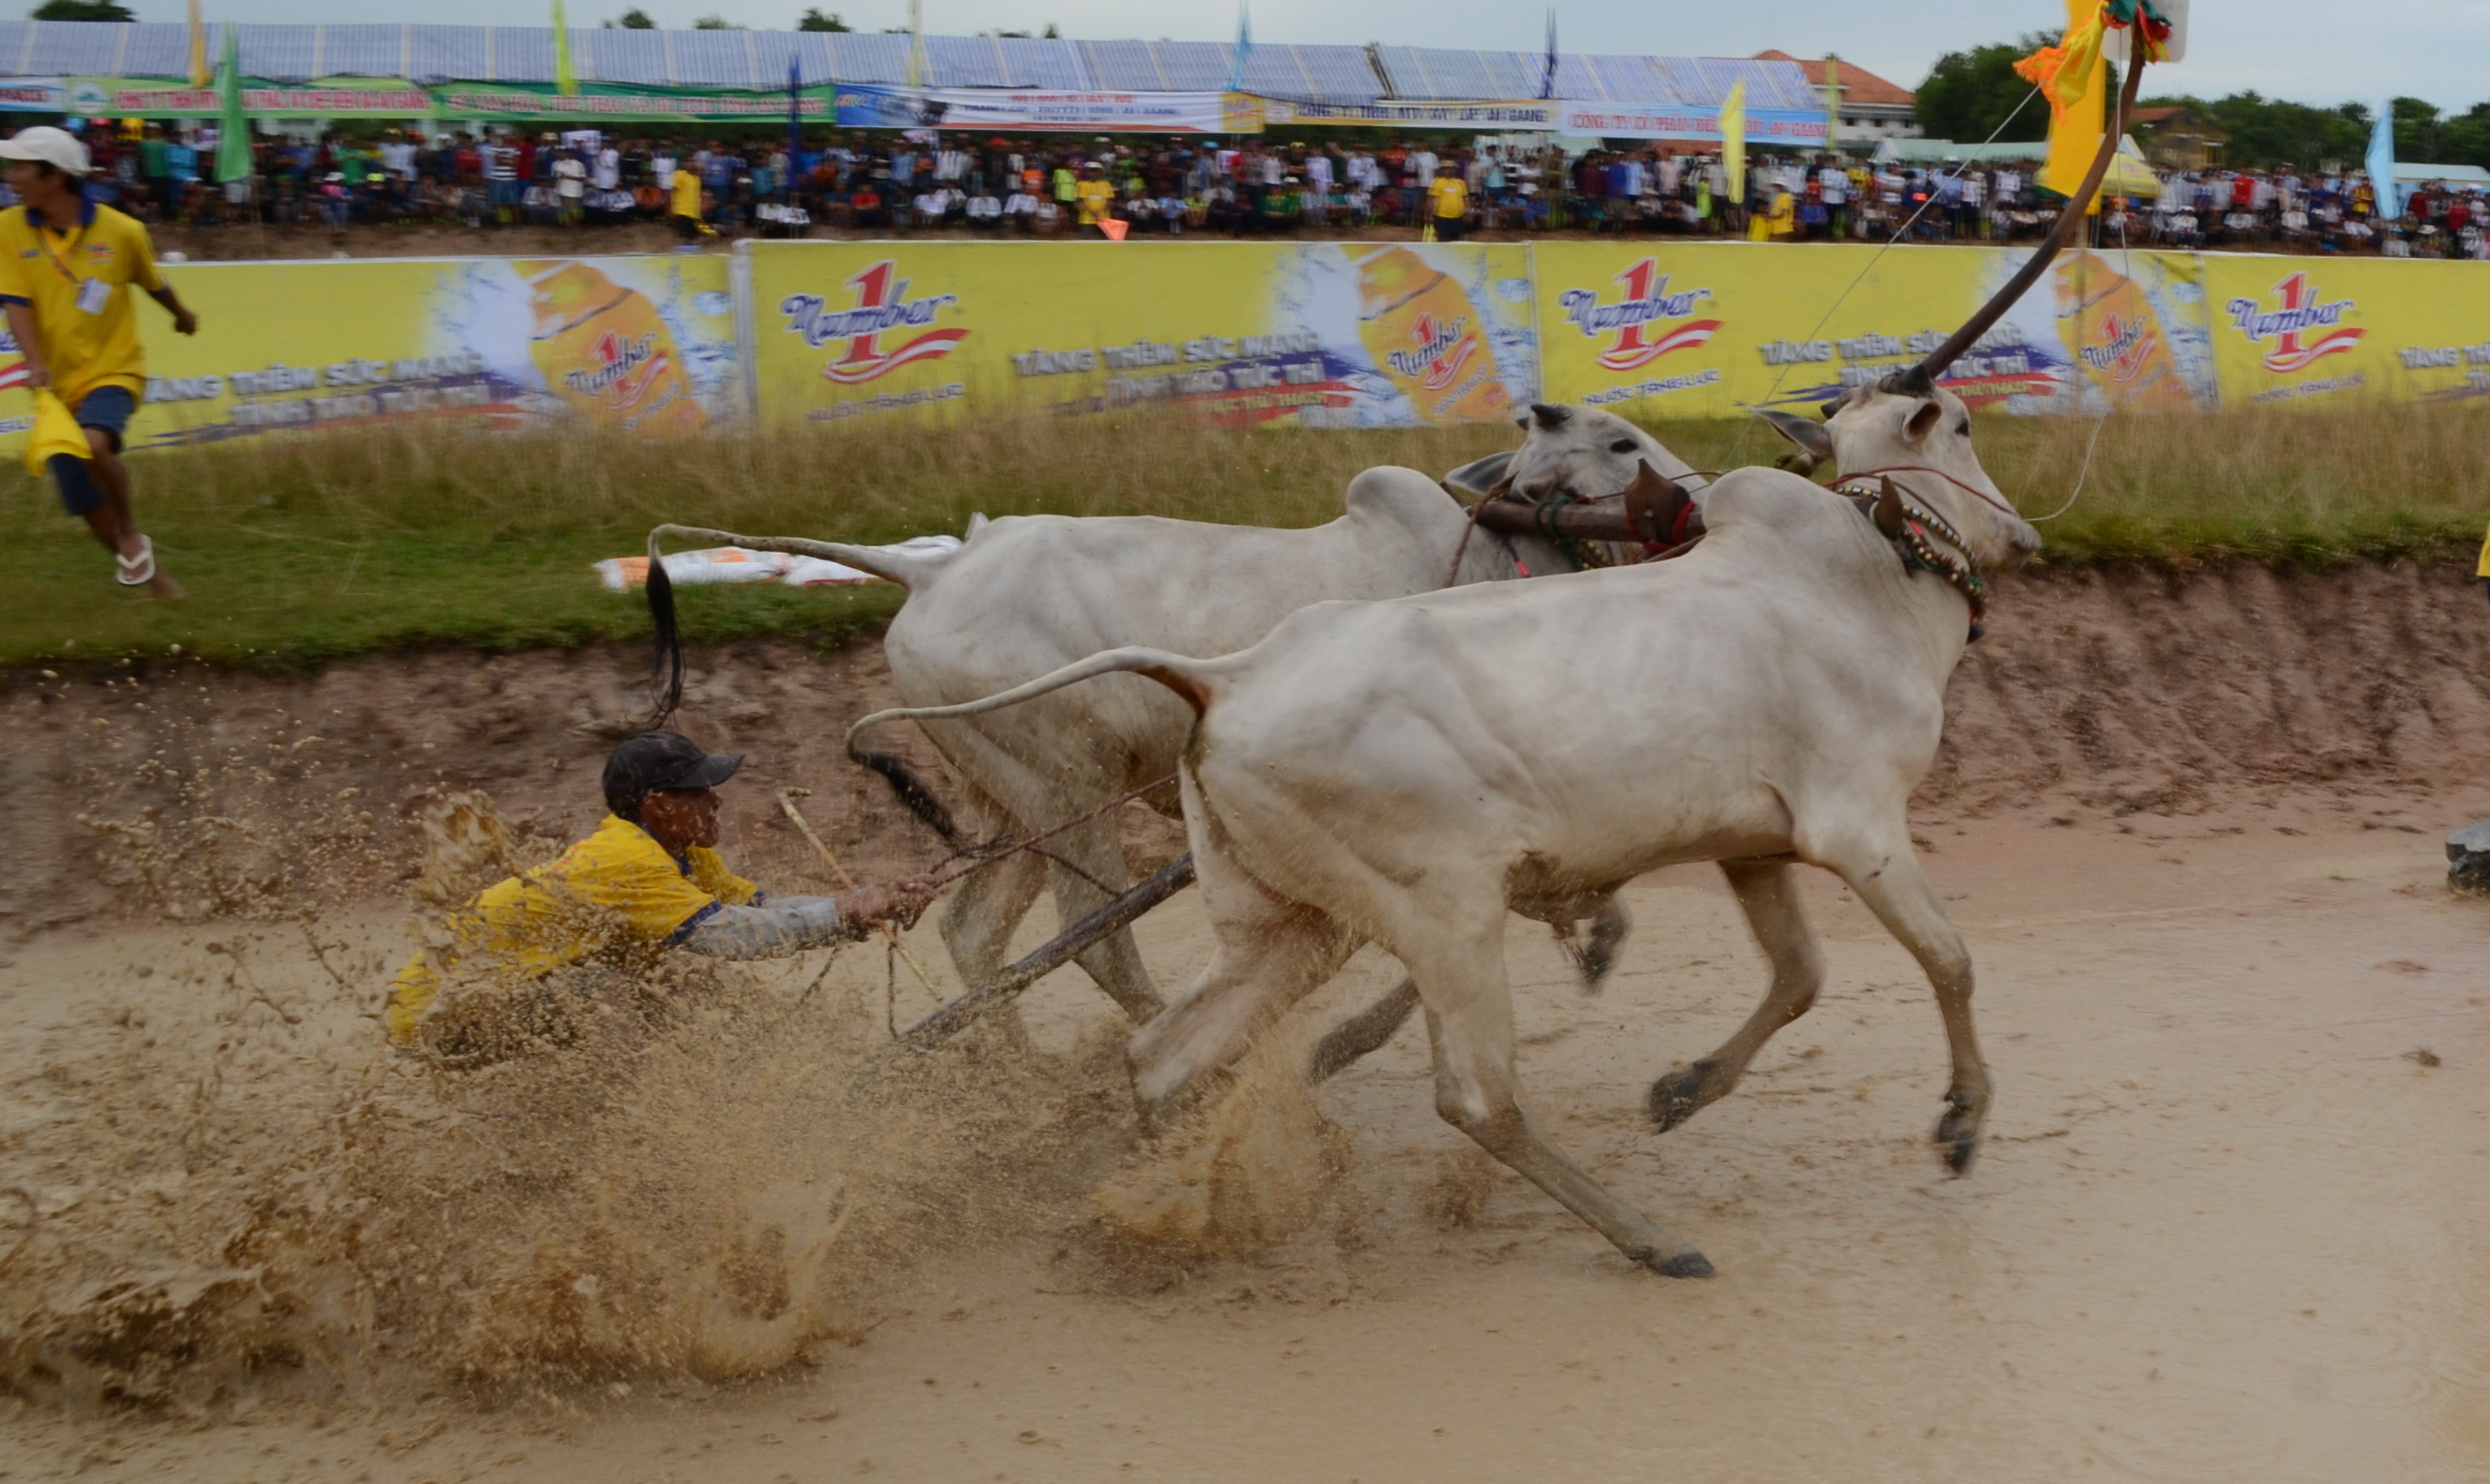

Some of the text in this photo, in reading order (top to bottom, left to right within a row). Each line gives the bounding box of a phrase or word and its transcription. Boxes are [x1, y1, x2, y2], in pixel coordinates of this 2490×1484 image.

[778, 277, 958, 347] Number
[826, 259, 898, 369] 1
[1557, 273, 1712, 338] Number
[1598, 256, 1659, 358] 1
[2225, 286, 2356, 343] Number
[2264, 270, 2308, 360] 1
[1012, 347, 1096, 377] TĂNG
[1100, 338, 1180, 369] THÊM
[1182, 334, 1238, 362] SỨC
[1385, 315, 1467, 378] Number
[1758, 338, 1833, 365] TĂNG
[1836, 331, 1902, 359] THÊM
[144, 374, 224, 403] ĂNG
[229, 363, 318, 395] THÊM
[325, 357, 388, 386] SỨC
